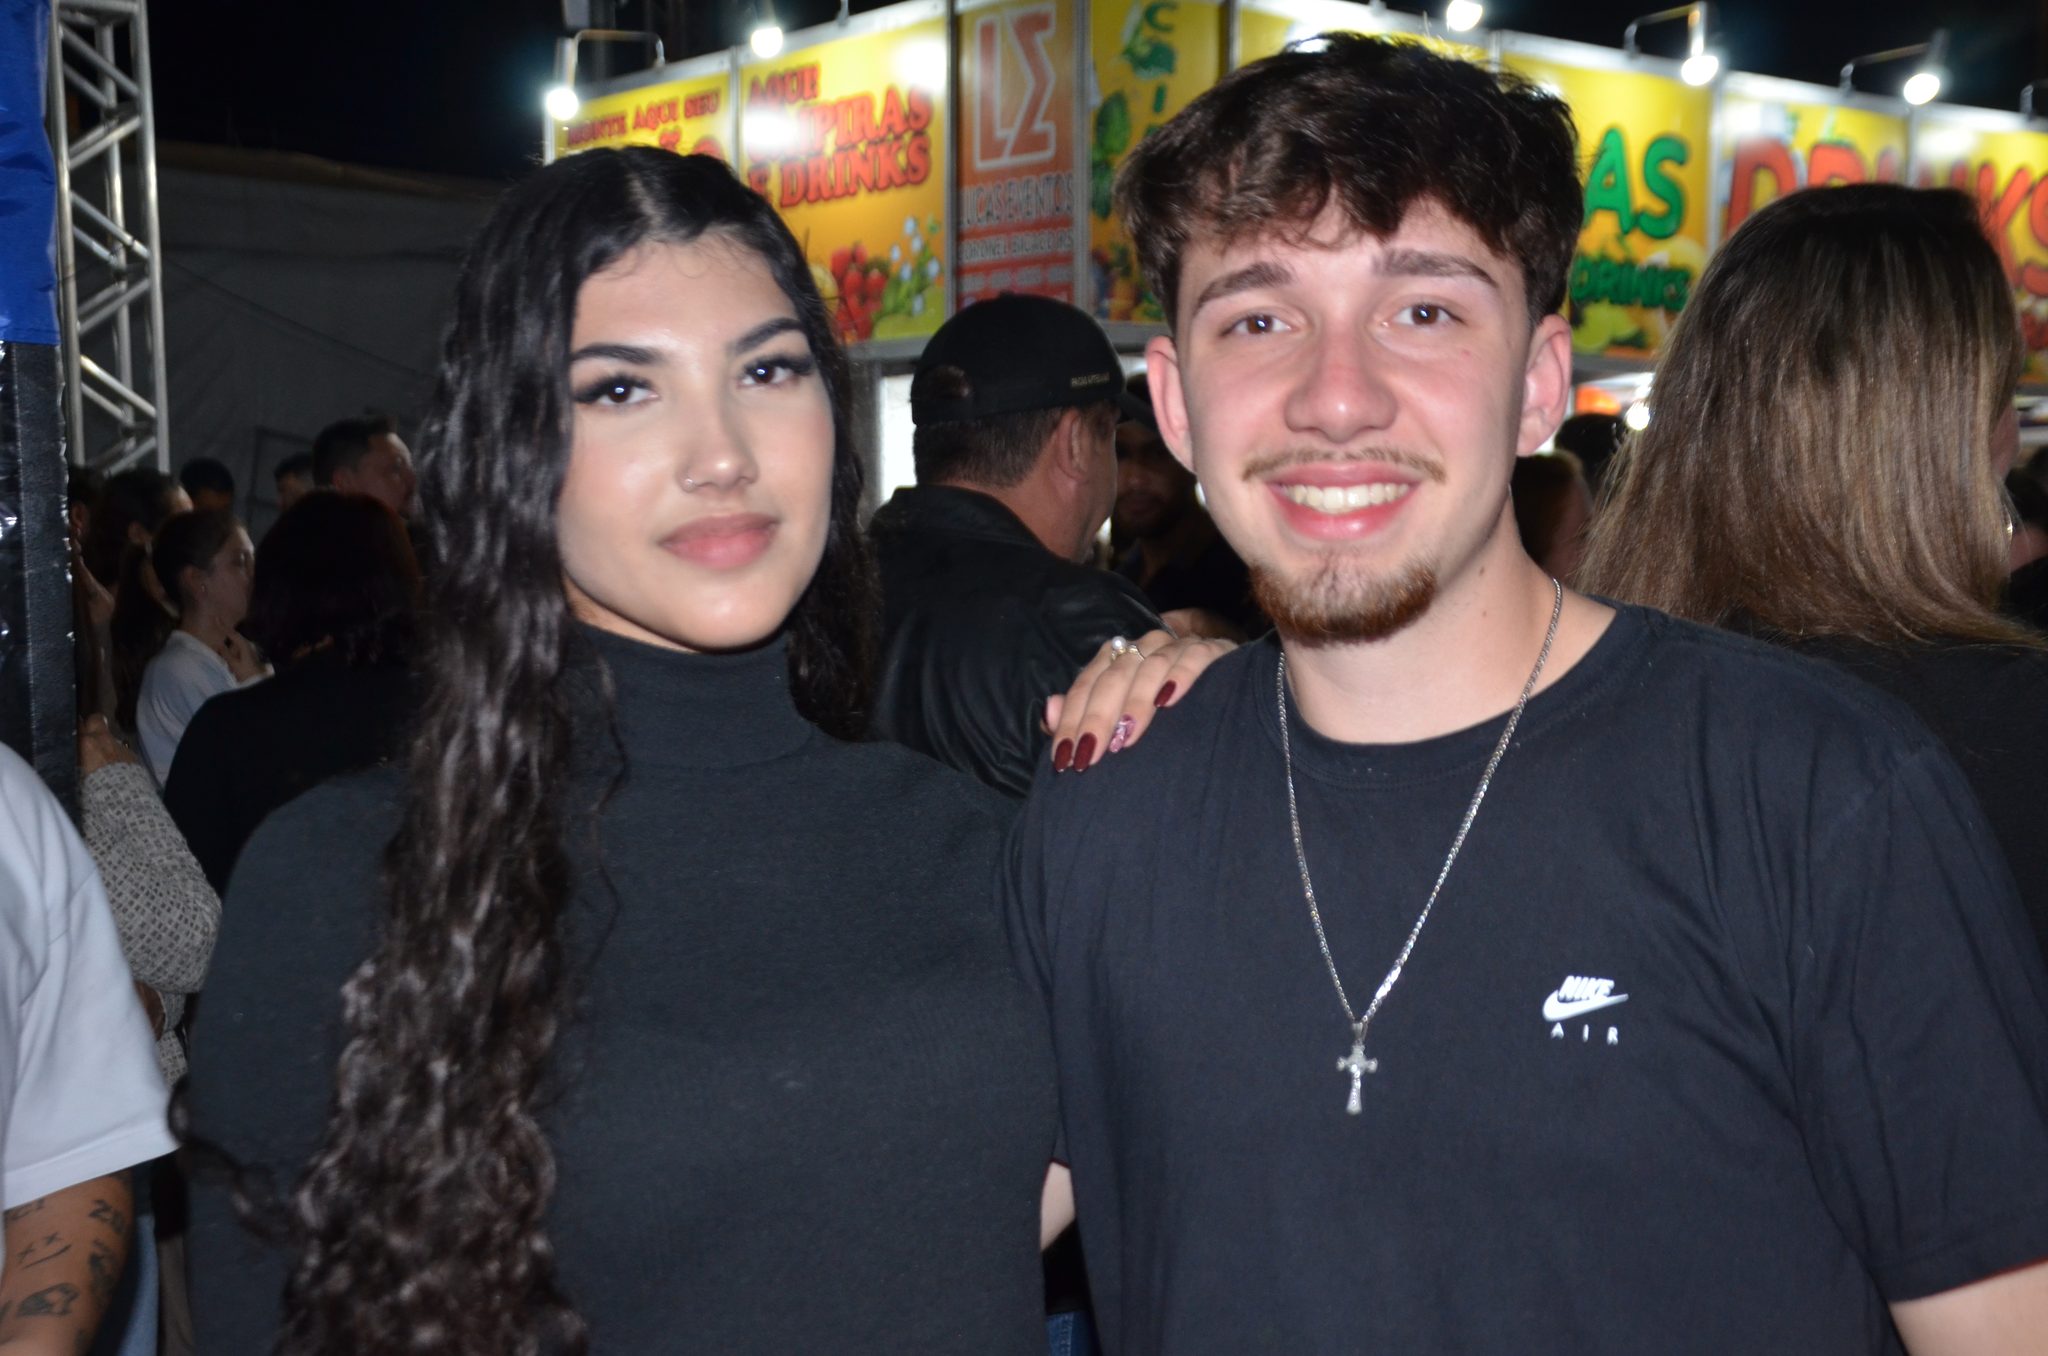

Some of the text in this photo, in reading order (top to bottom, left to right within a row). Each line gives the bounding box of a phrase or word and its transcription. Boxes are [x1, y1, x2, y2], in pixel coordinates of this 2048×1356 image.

[632, 97, 680, 131] AQUI
[684, 87, 721, 118] SEU
[748, 86, 932, 162] IPIRAS
[780, 135, 931, 208] DRINKS
[1007, 170, 1074, 223] EVENTOS
[1583, 127, 1689, 240] AS
[1726, 137, 2048, 298] DKS
[1557, 974, 1616, 1001] NIKE
[1550, 1021, 1619, 1046] AIR
